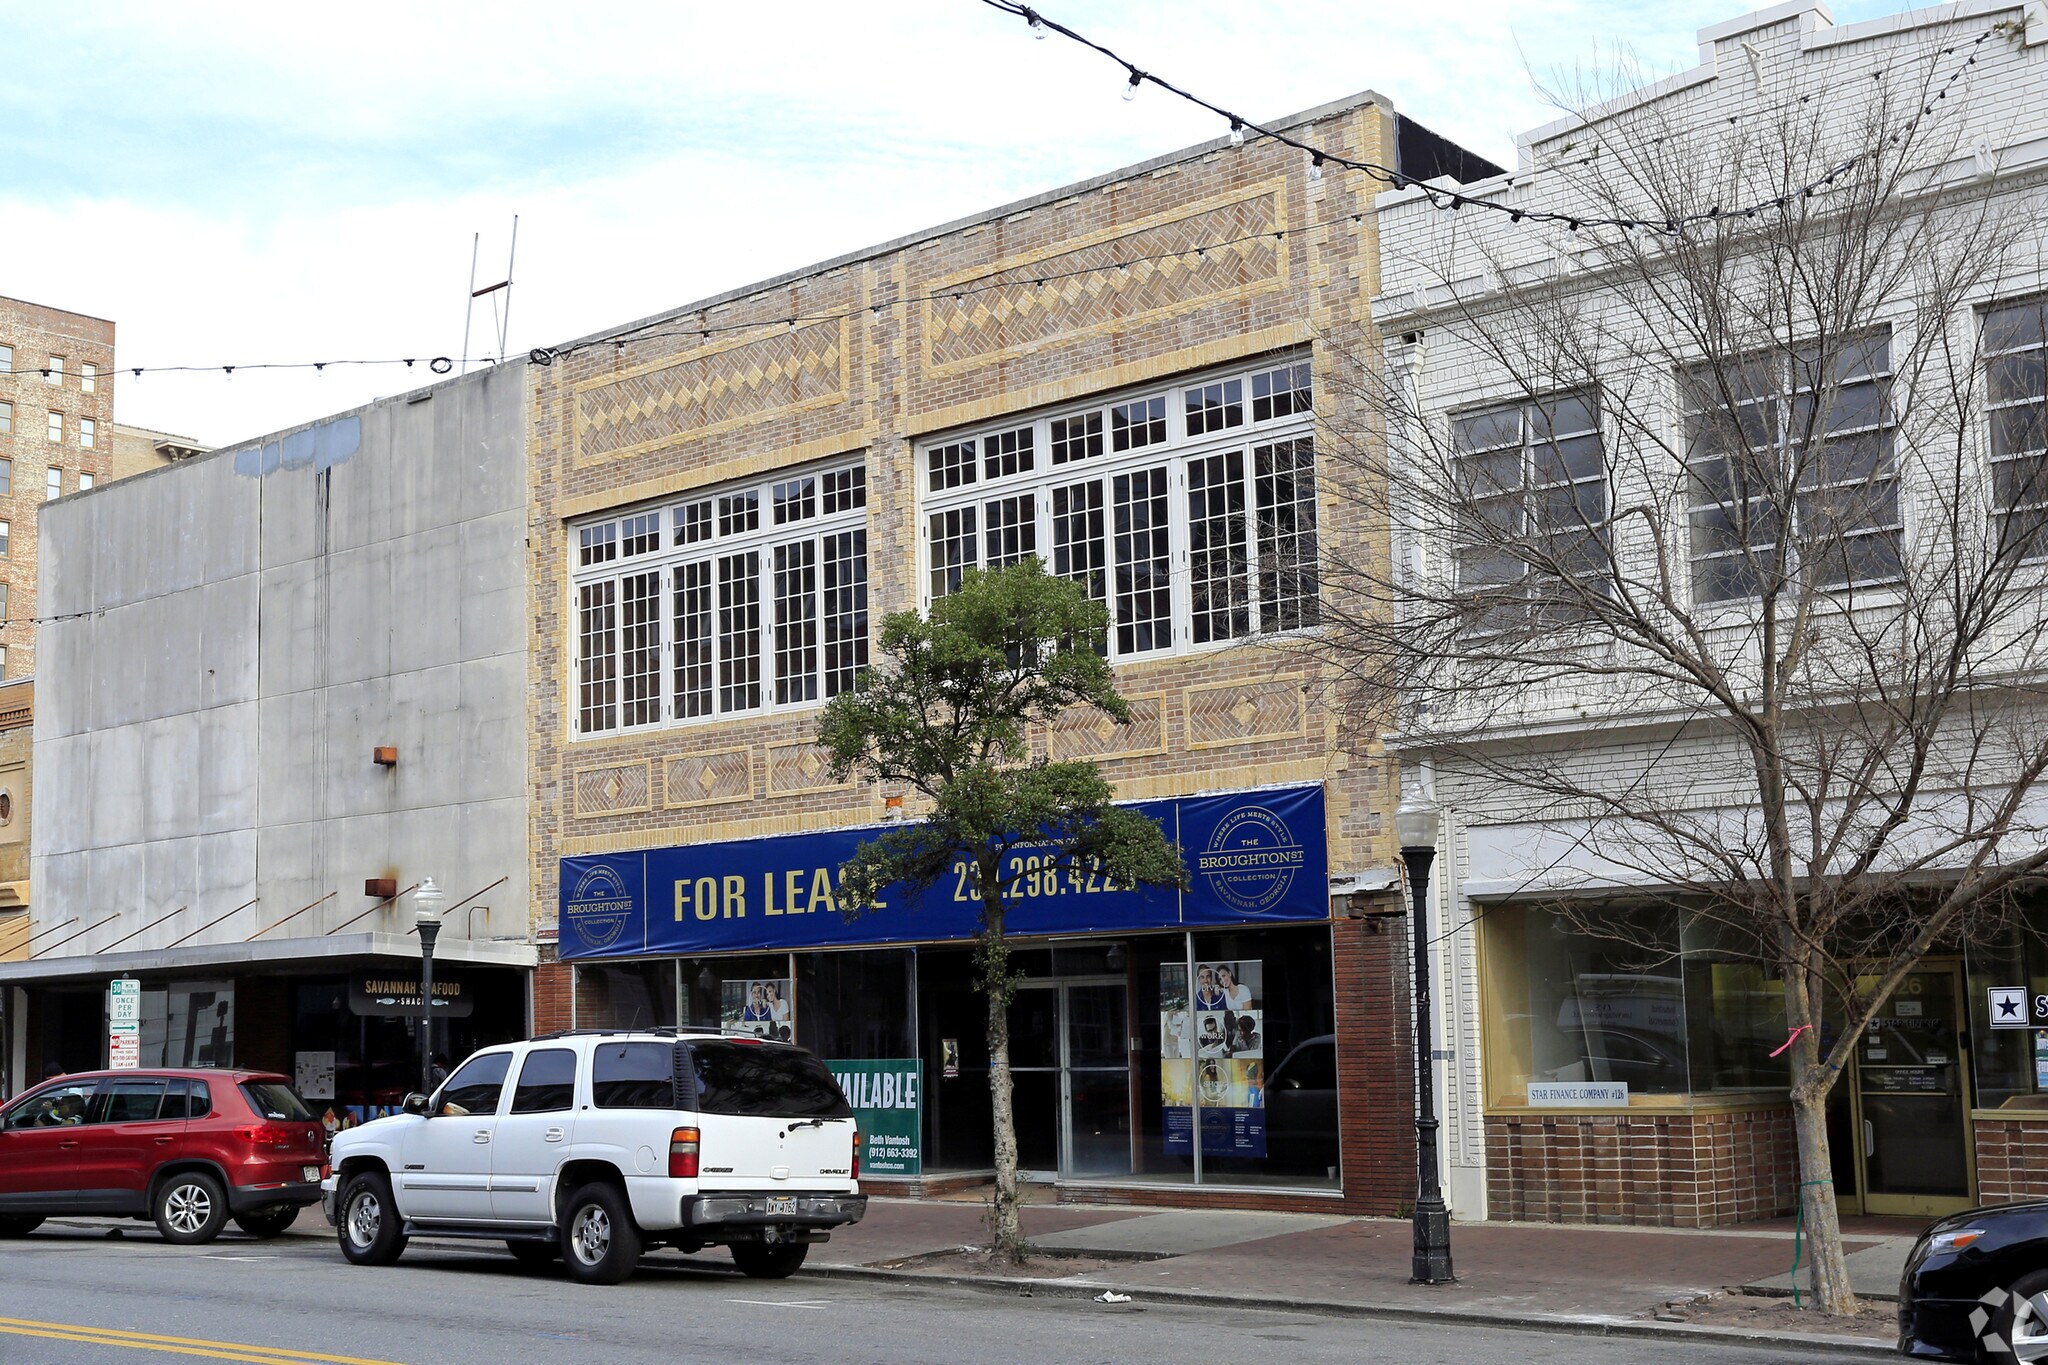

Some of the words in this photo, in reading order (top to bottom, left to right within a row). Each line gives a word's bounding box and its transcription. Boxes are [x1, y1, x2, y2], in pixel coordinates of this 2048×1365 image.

[1213, 823, 1230, 848] WHERE
[1230, 812, 1246, 823] LIFE
[1247, 811, 1271, 822] MEETS
[1270, 820, 1288, 843] STYLE
[1199, 852, 1291, 869] BROUGHTON
[1227, 874, 1276, 882] COLLECTION
[674, 875, 746, 922] FOR
[764, 864, 887, 916] LEAS
[1259, 875, 1288, 906] GEORGIA
[567, 902, 624, 914] BROUGHTON
[112, 983, 121, 993] 30
[365, 980, 416, 994] SAVANNAH
[420, 982, 460, 996] SAFOOD
[1892, 978, 1922, 995] 26
[400, 997, 424, 1006] SHAC
[832, 1072, 917, 1109] AILABLE
[1532, 1090, 1548, 1100] STAR
[1550, 1089, 1578, 1100] FINANCE
[1580, 1088, 1610, 1100] COMPANY
[1612, 1089, 1625, 1100] #126
[870, 1135, 884, 1144] Beth
[884, 1135, 910, 1146] Vantosh
[868, 1147, 886, 1159] (912)
[886, 1148, 918, 1158] 663-3392
